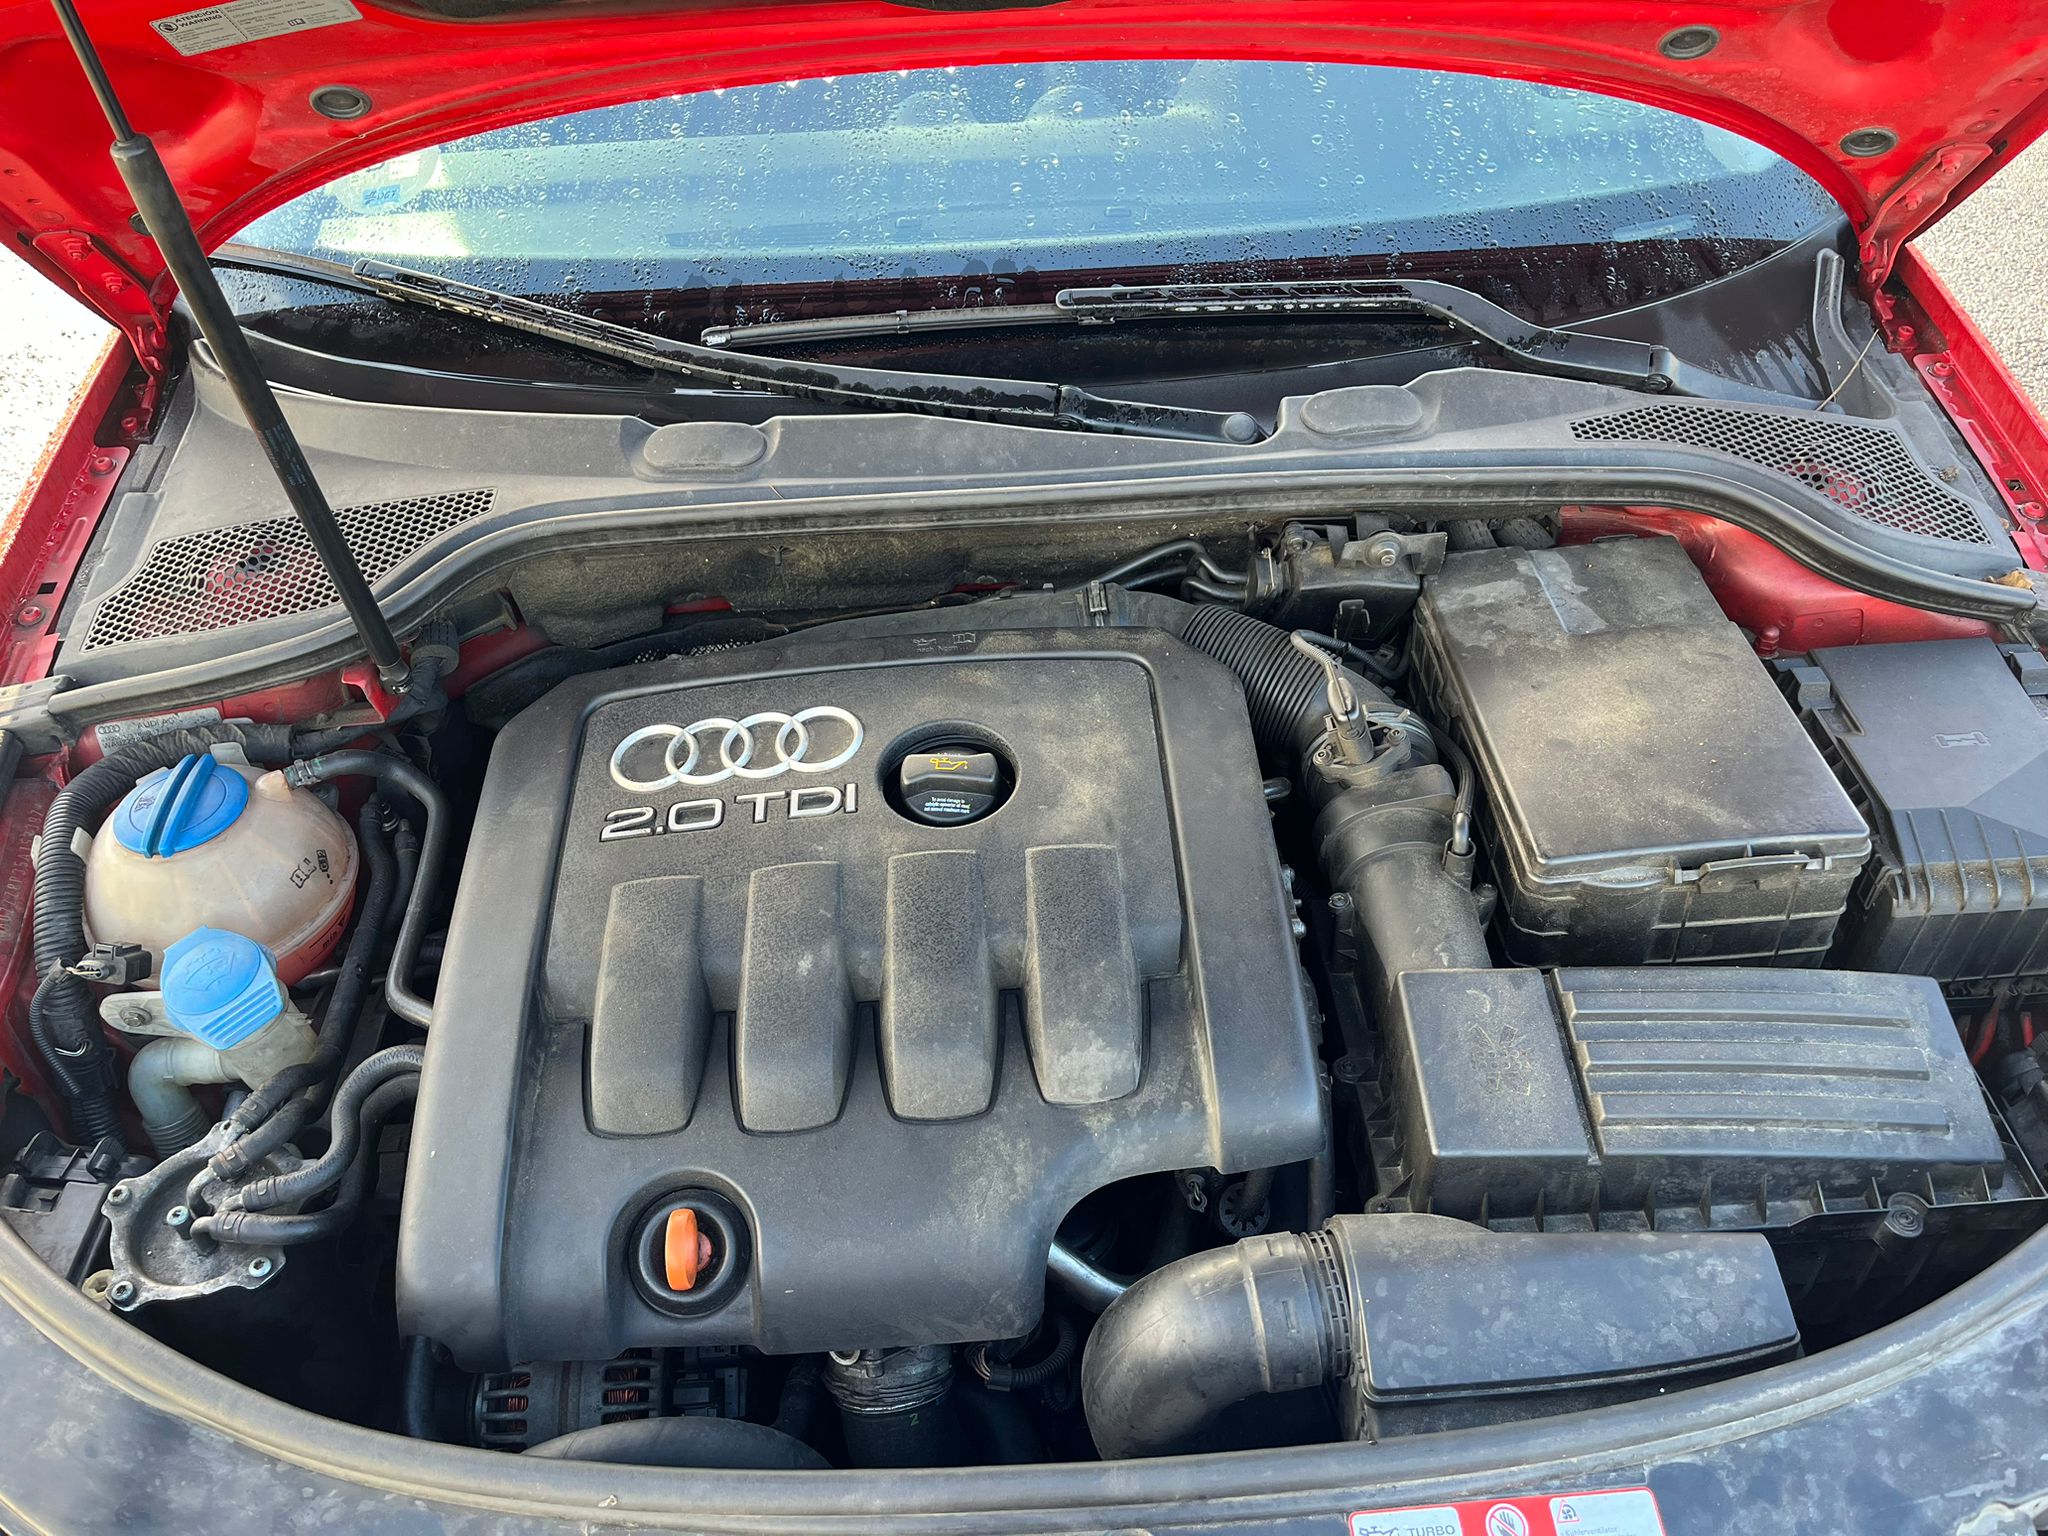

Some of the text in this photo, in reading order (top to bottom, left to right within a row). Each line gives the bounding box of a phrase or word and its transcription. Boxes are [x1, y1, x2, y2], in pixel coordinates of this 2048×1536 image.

[175, 9, 219, 23] ATENCIÓN
[178, 15, 222, 27] WARNING
[137, 720, 159, 729] AUDI
[600, 782, 858, 842] 2.0 TDI
[323, 931, 337, 948] min
[1407, 1524, 1455, 1536] TURBO
